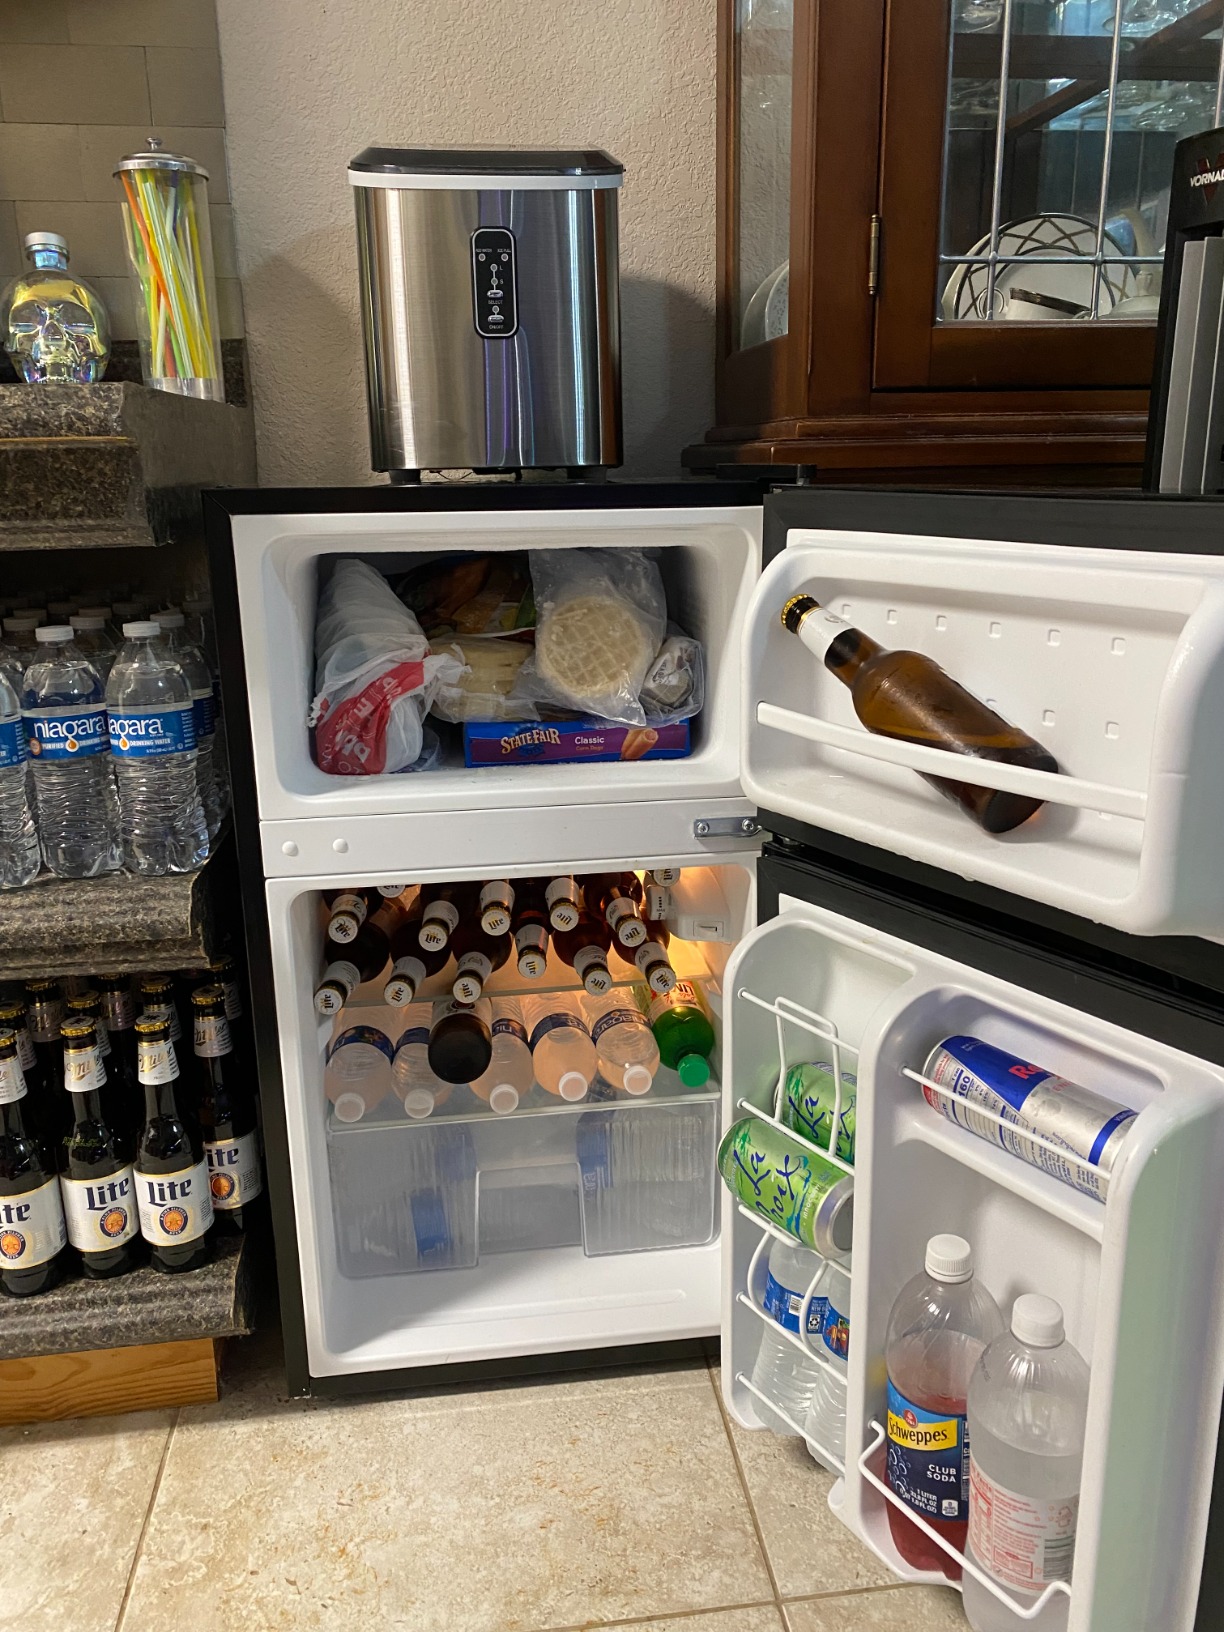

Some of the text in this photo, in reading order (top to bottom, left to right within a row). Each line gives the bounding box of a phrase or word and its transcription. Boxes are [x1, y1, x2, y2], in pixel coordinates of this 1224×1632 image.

[1190, 168, 1224, 187] VORNAD
[33, 715, 106, 740] niagara
[107, 717, 164, 739] iagara
[500, 727, 562, 754] STATE FAIR
[574, 735, 605, 745] Classic
[488, 918, 504, 931] Lite
[556, 912, 573, 926] Lite
[335, 922, 351, 938] Lite
[624, 926, 641, 941] Lite
[425, 933, 442, 944] Lite
[525, 960, 537, 975] Lite
[591, 978, 606, 990] Lite
[655, 974, 670, 989] Lite
[392, 987, 404, 1002] Lite
[462, 982, 474, 998] Lite
[324, 994, 334, 1009] Lite
[1008, 1064, 1044, 1080] Re
[206, 1148, 240, 1173] ite
[733, 1149, 772, 1197] La
[85, 1176, 131, 1211] Lite
[146, 1178, 193, 1208] Lite
[0, 1203, 31, 1229] te
[889, 1418, 948, 1446] Schweppes
[928, 1463, 957, 1475] CLUB
[926, 1471, 957, 1483] SODA
[920, 1489, 938, 1501] LITER
